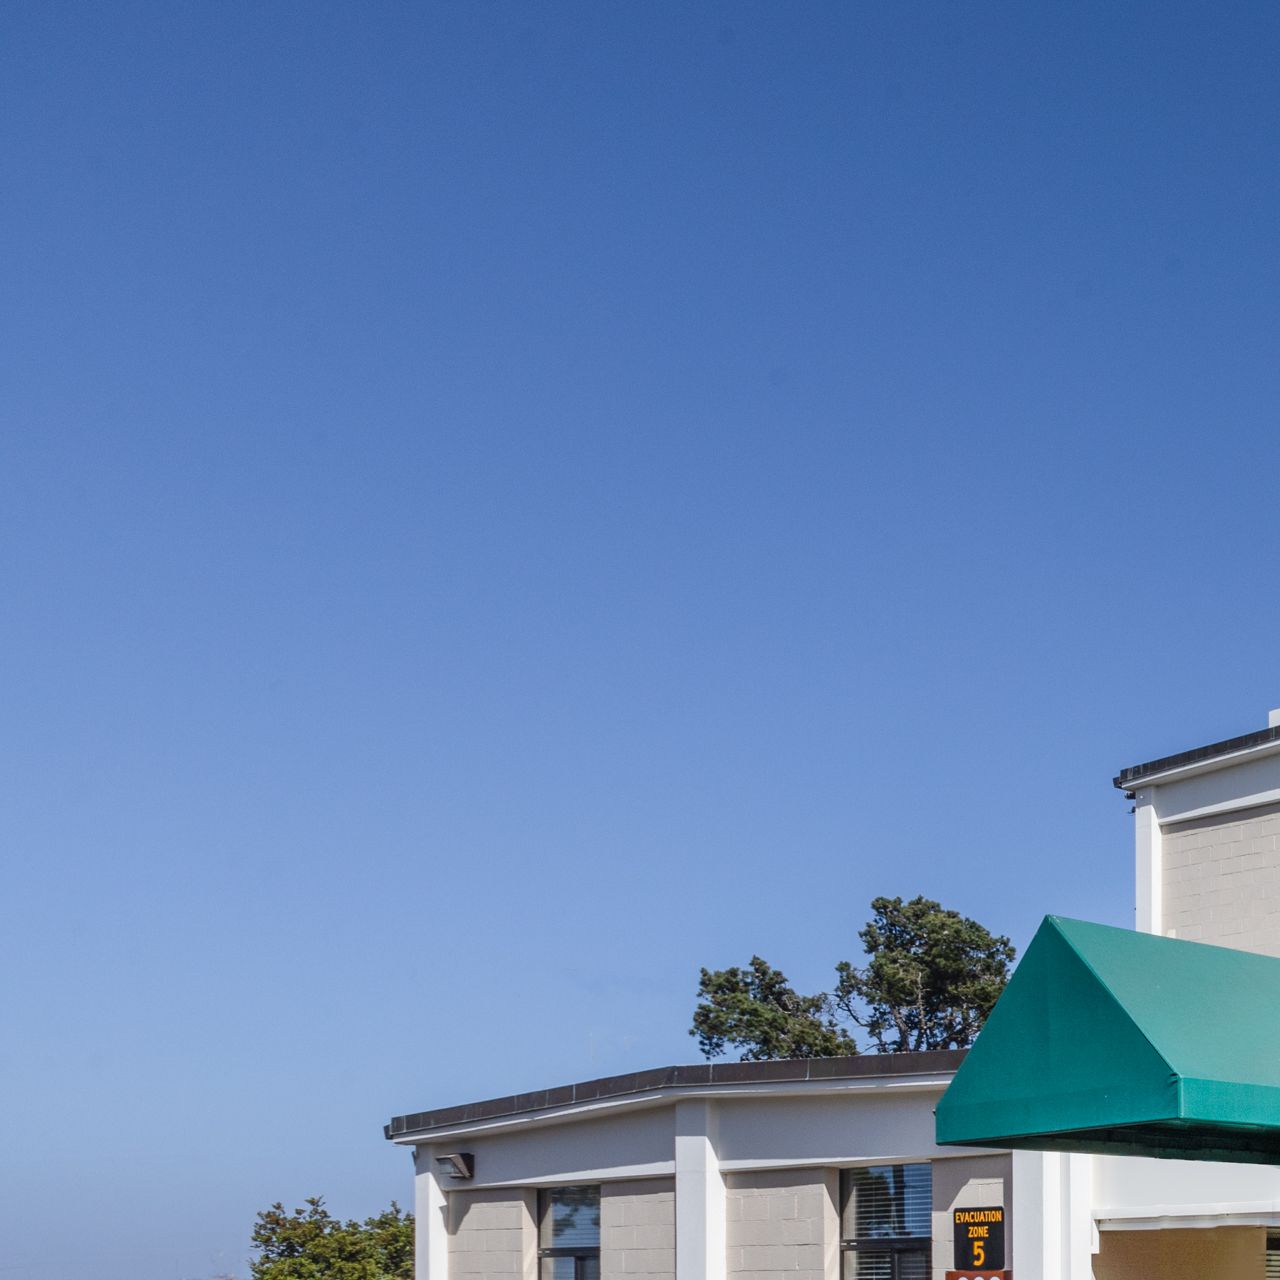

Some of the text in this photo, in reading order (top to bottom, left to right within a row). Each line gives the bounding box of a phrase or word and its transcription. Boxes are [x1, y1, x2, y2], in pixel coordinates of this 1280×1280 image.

[955, 1210, 1002, 1224] EVACUATION
[968, 1226, 989, 1238] ZONE
[973, 1241, 985, 1267] 5
